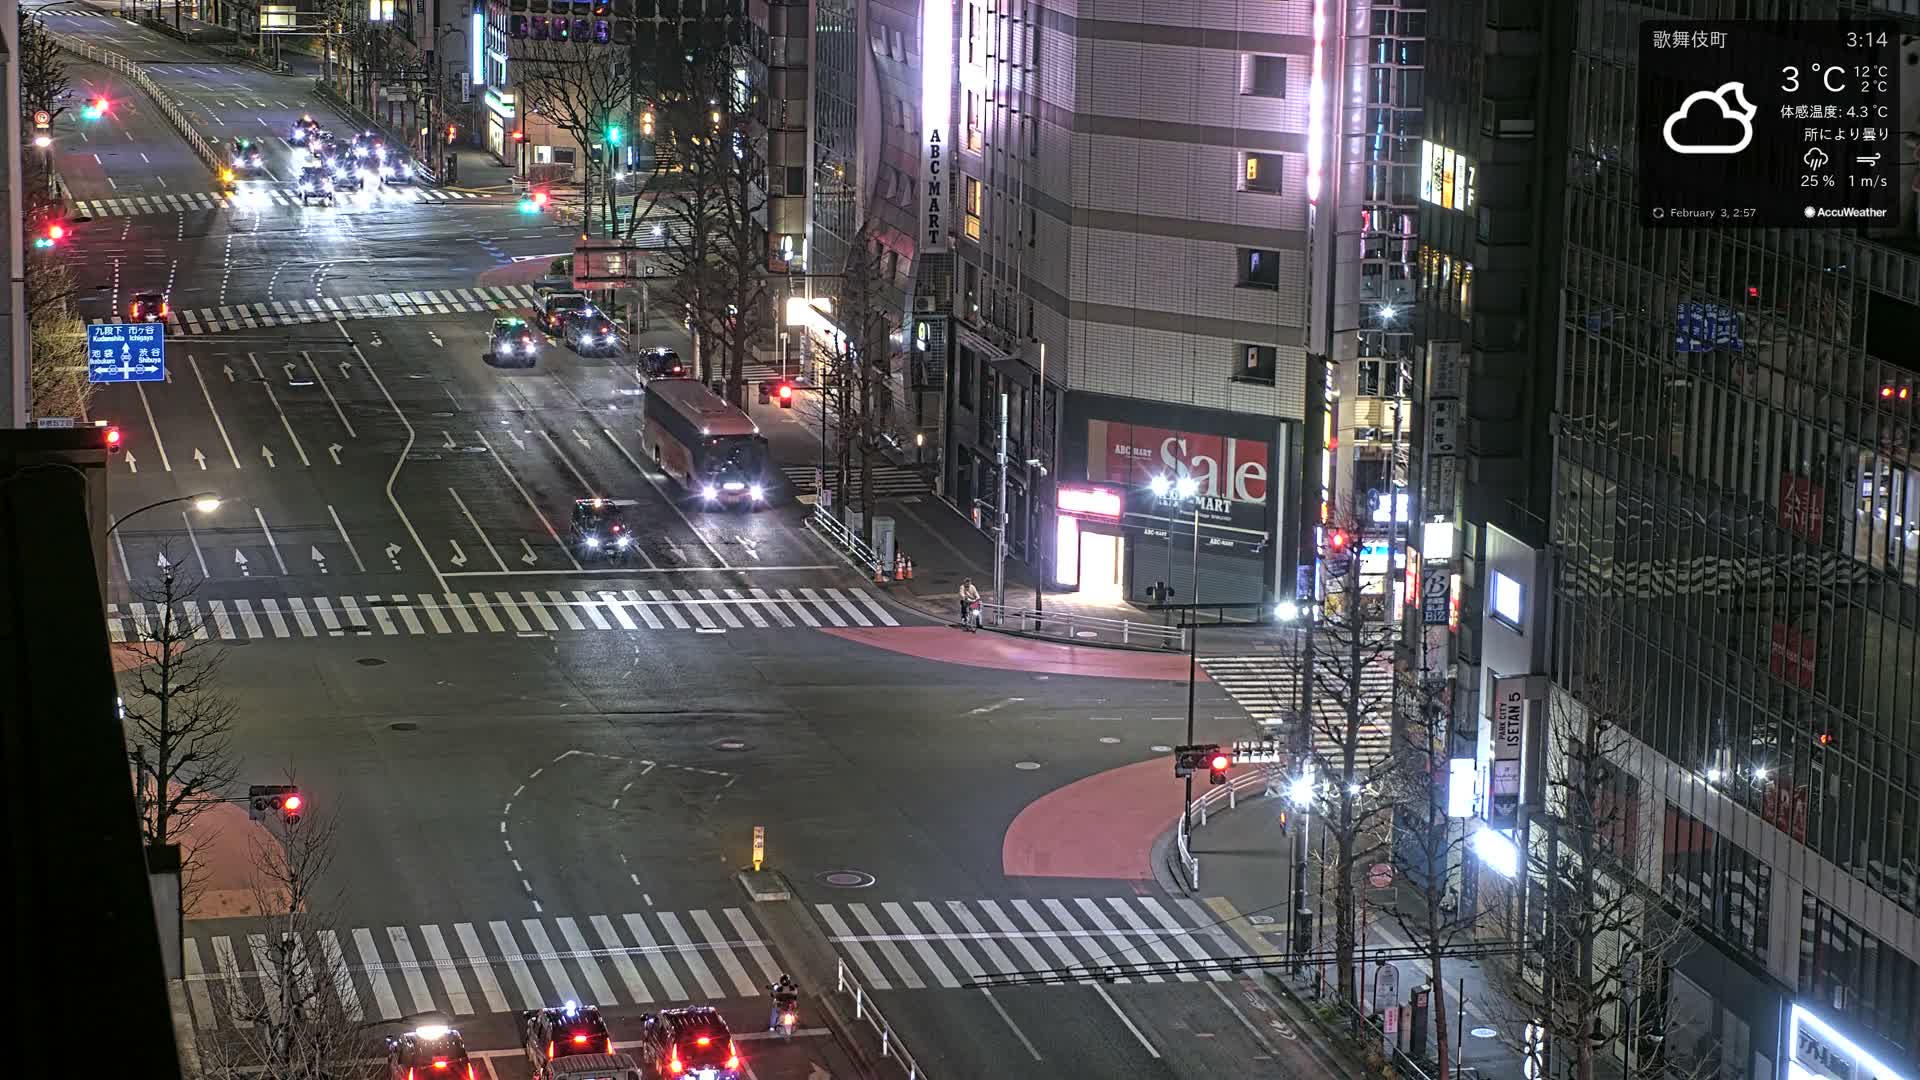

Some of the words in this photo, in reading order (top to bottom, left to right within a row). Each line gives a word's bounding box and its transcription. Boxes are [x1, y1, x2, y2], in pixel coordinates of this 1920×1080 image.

[95, 326, 123, 335] 九段下
[139, 348, 161, 357] 渋谷
[1160, 437, 1267, 503] Sale
[1509, 692, 1521, 702] 5
[1499, 703, 1507, 720] CITY
[1499, 722, 1507, 740] PARK
[1507, 706, 1520, 746] ISETAN
